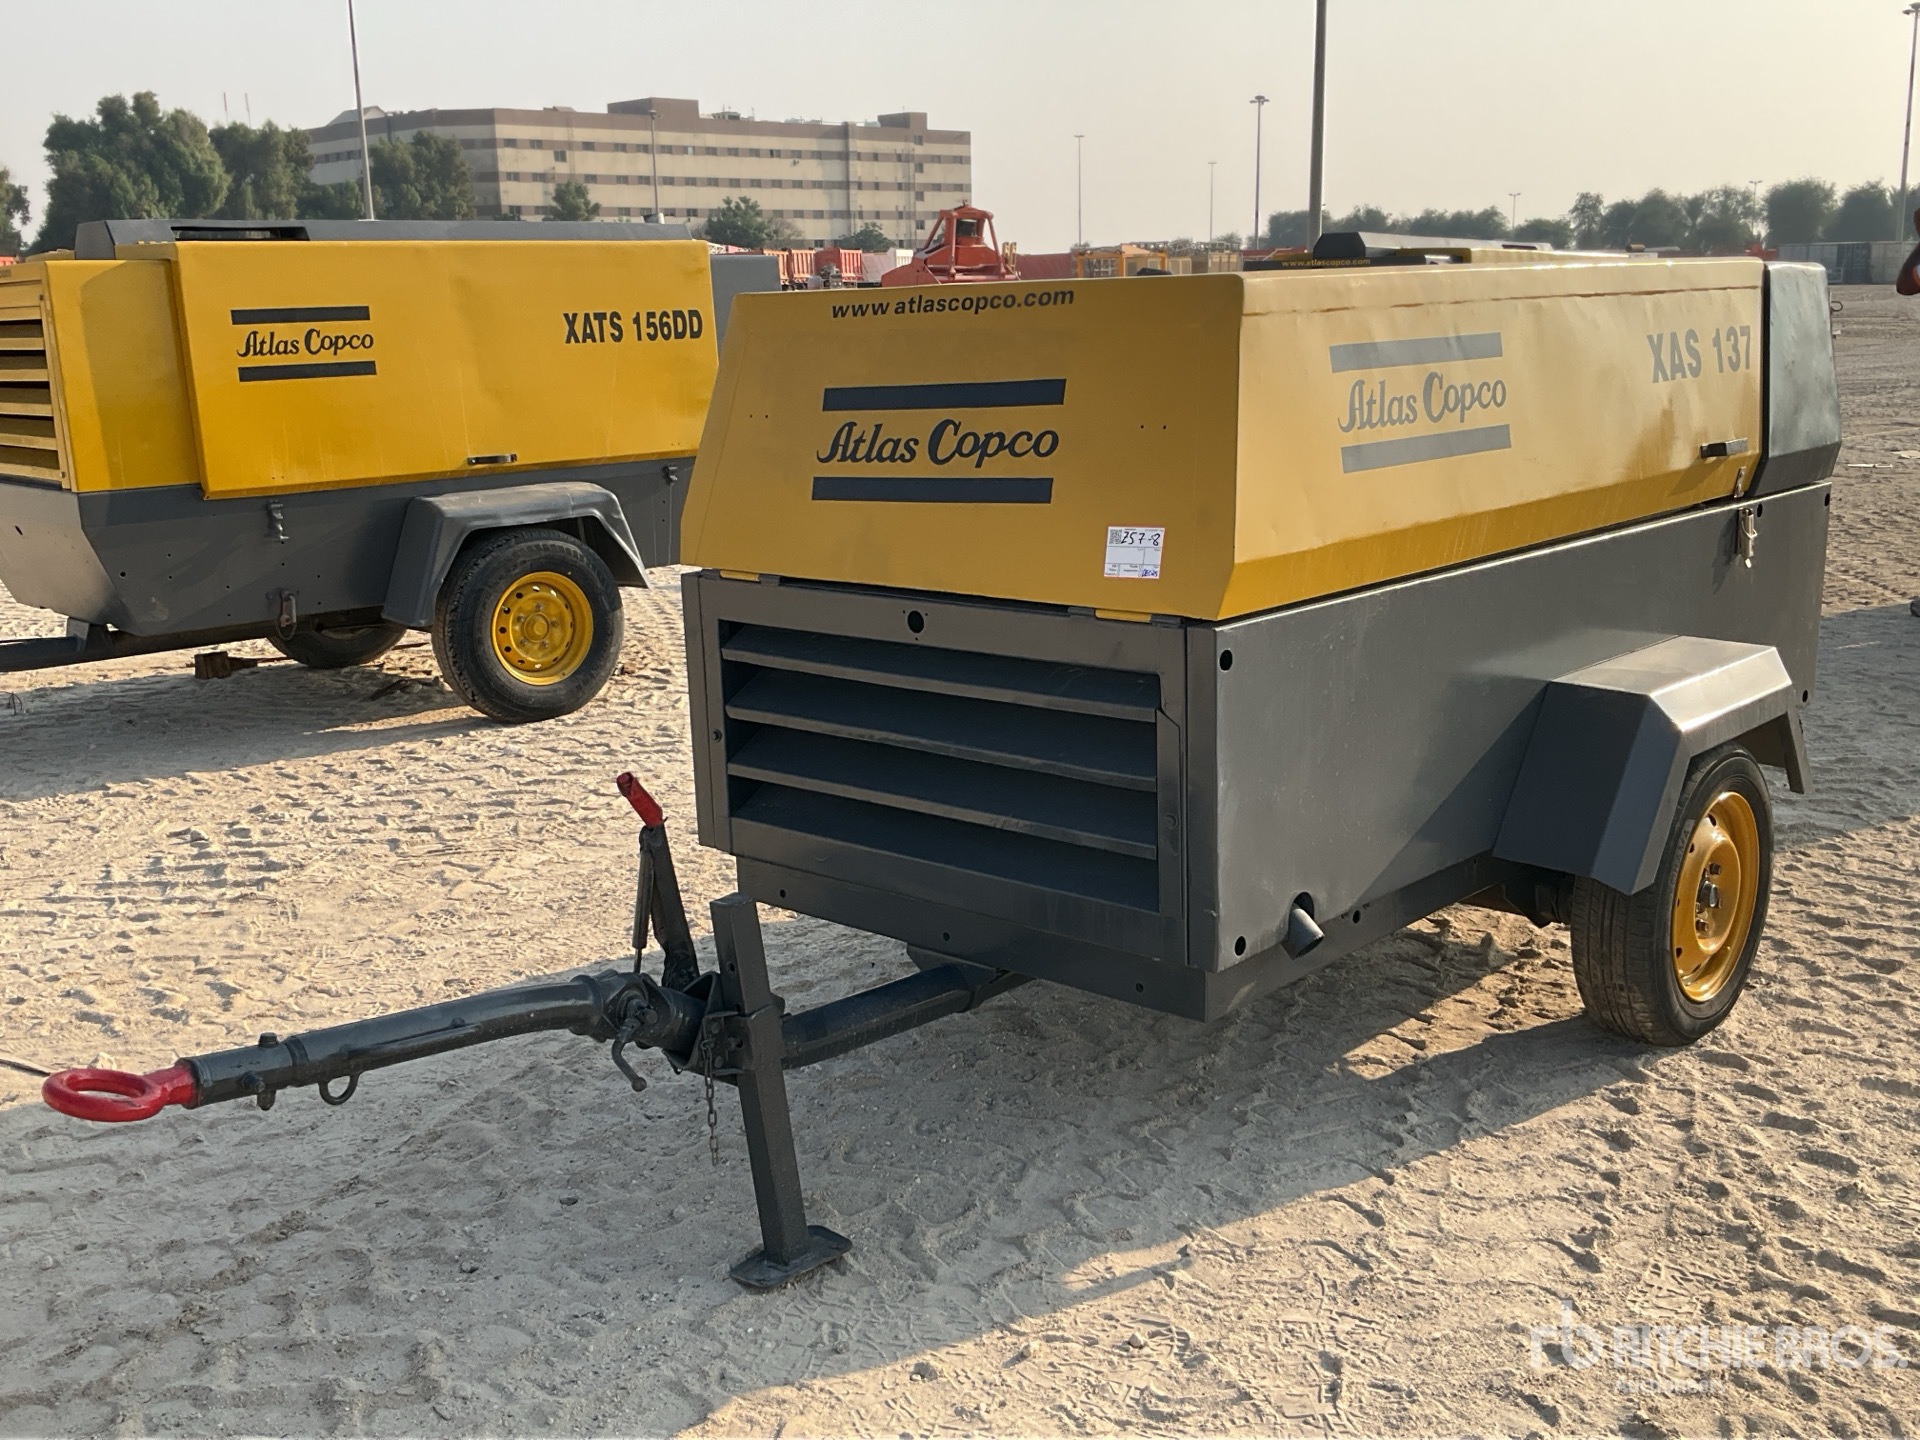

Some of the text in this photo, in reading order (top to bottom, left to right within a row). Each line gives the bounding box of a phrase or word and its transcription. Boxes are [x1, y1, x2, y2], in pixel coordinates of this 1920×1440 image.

[237, 328, 374, 358] Atlas Copco
[563, 309, 703, 344] XATS 156DD
[1646, 325, 1751, 384] XAS 137
[1338, 371, 1507, 433] Atlas Copco
[816, 418, 1060, 469] Atlas Copco
